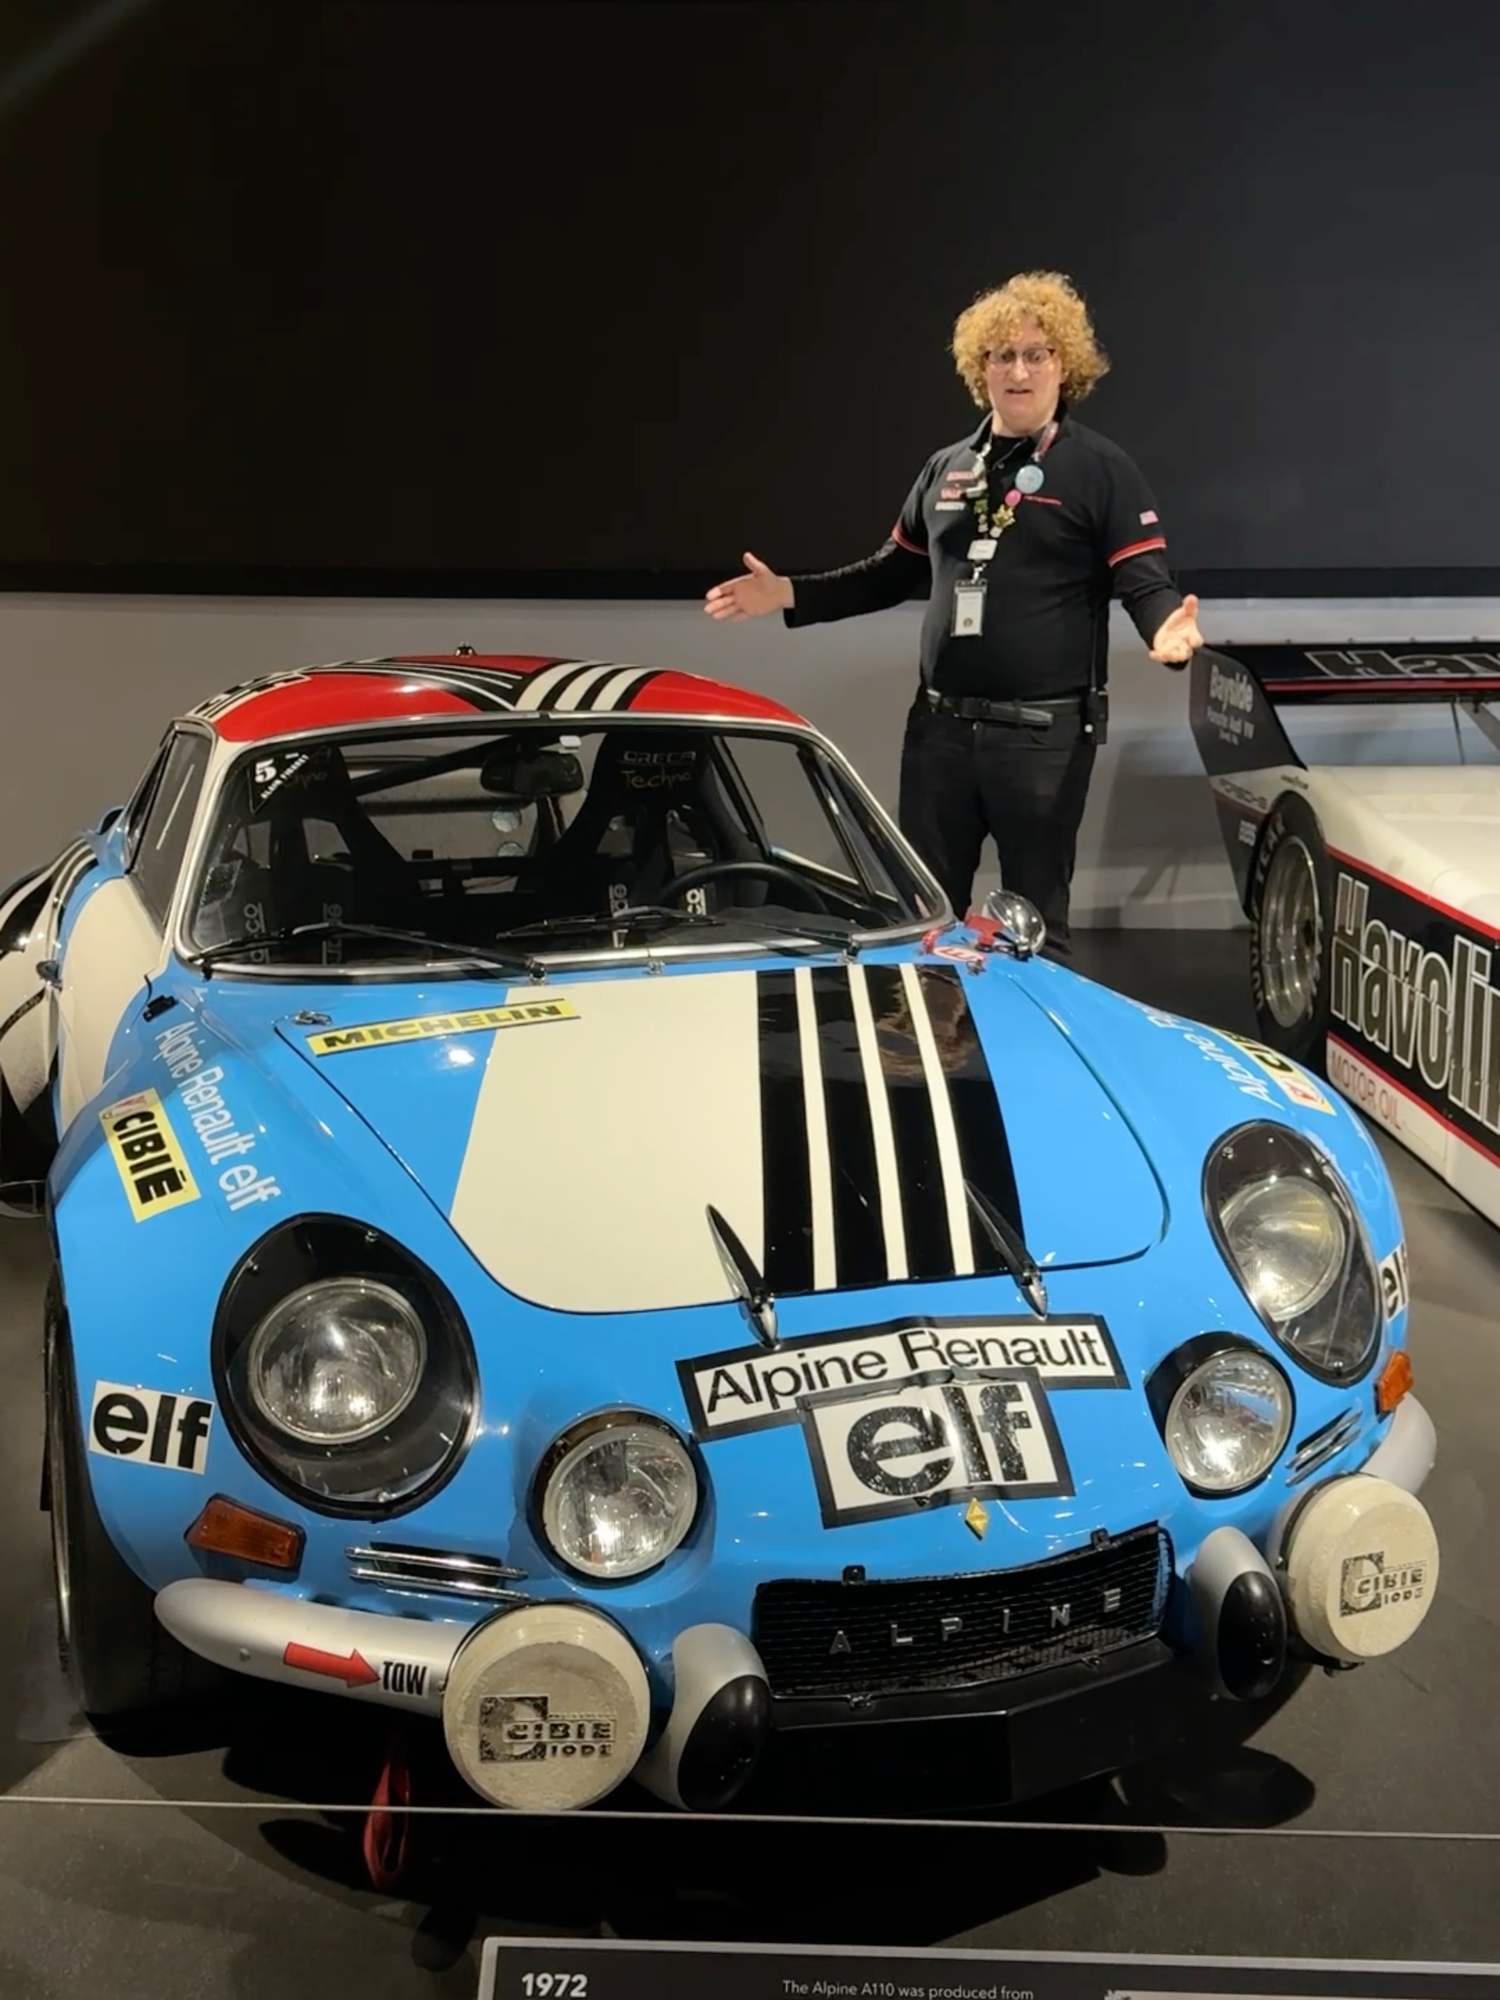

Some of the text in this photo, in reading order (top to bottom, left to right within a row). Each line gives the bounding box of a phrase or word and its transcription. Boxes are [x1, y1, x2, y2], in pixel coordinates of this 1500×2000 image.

[255, 758, 278, 783] 5
[621, 762, 691, 790] Techno
[324, 1005, 562, 1048] MICHELIN
[1331, 1050, 1378, 1107] MOTOR
[1379, 1085, 1403, 1131] OIL
[153, 1021, 282, 1211] Alpine Renault elf
[706, 1328, 1107, 1420] Alpine Renault
[94, 1393, 212, 1469] elf
[846, 1384, 1032, 1496] elf
[1357, 1568, 1423, 1594] CIBIE
[829, 1587, 1122, 1655] ALPINE
[383, 1661, 428, 1696] TOW
[507, 1722, 612, 1740] CIBIE
[521, 1972, 589, 1998] 1972
[782, 1979, 1034, 2000] The Alpine A110 was produced from
